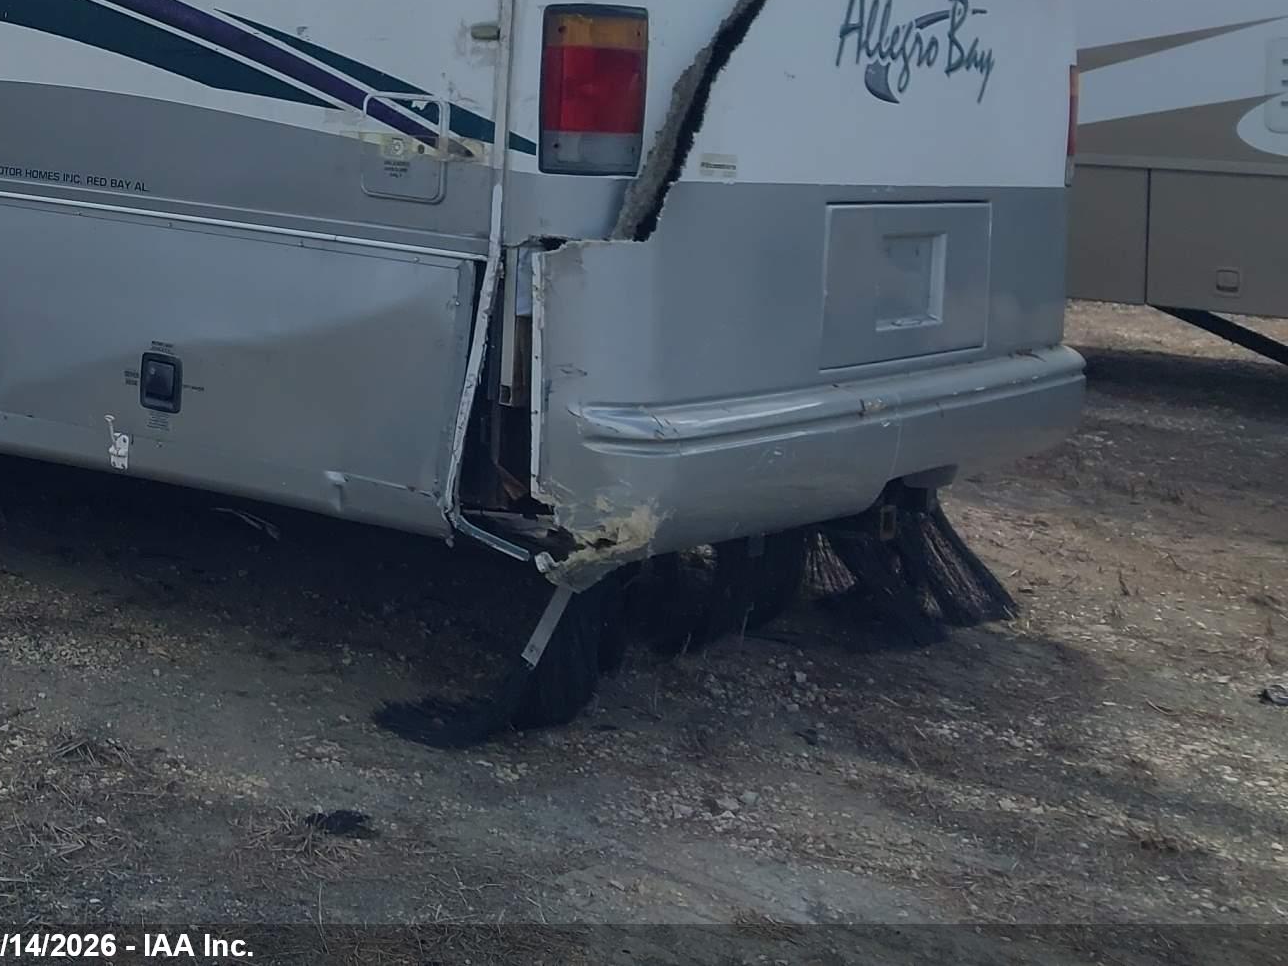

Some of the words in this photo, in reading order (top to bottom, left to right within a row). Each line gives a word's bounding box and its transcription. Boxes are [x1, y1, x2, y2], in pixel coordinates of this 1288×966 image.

[25, 168, 61, 182] HOMES
[86, 175, 107, 188] RED
[110, 178, 132, 190] BAY
